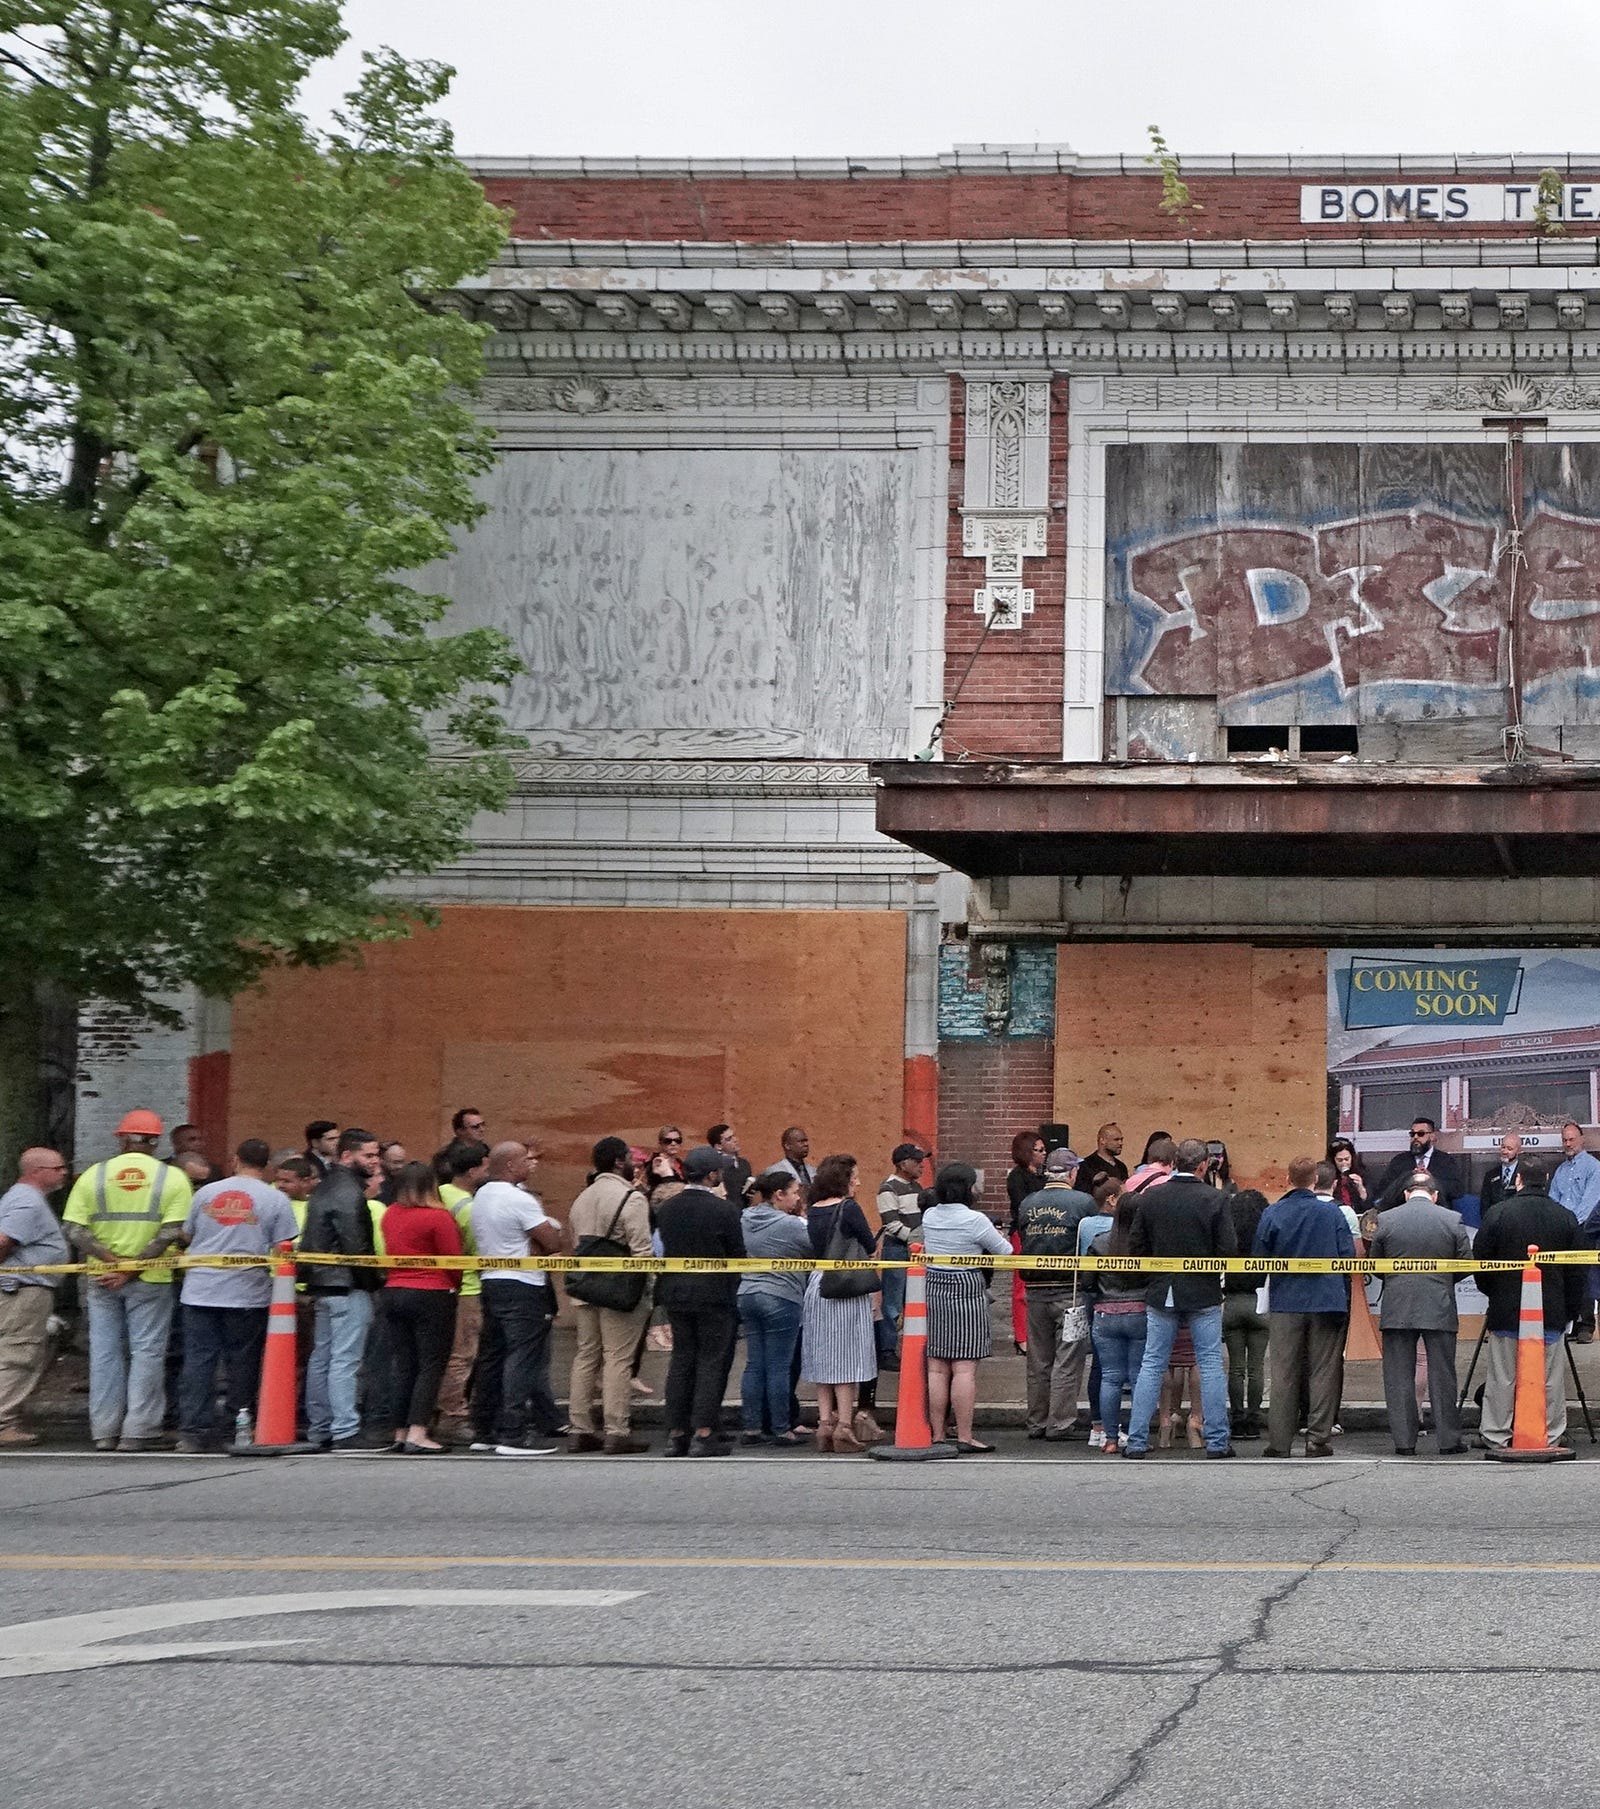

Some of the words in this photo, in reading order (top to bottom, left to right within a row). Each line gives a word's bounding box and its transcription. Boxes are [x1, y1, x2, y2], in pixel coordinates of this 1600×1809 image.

[1320, 187, 1469, 219] BOMES
[1354, 969, 1480, 992] COMING
[1415, 993, 1499, 1017] SOON
[1492, 1136, 1540, 1147] LITAD
[478, 1258, 521, 1269] CAUTION
[537, 1258, 580, 1270] CAUTION
[622, 1259, 666, 1270] CAUTION
[683, 1259, 728, 1270] CAUTION
[771, 1260, 817, 1270] CAUTION
[911, 1255, 934, 1264] TION
[950, 1256, 994, 1266] CAUTION
[1036, 1257, 1080, 1269] CAUTION
[1096, 1258, 1141, 1270] CAUTION
[1183, 1259, 1227, 1271] CAUTION
[1244, 1259, 1289, 1271] CAUTION
[1331, 1260, 1376, 1271] CAUTION
[1392, 1260, 1437, 1272] CAUTION
